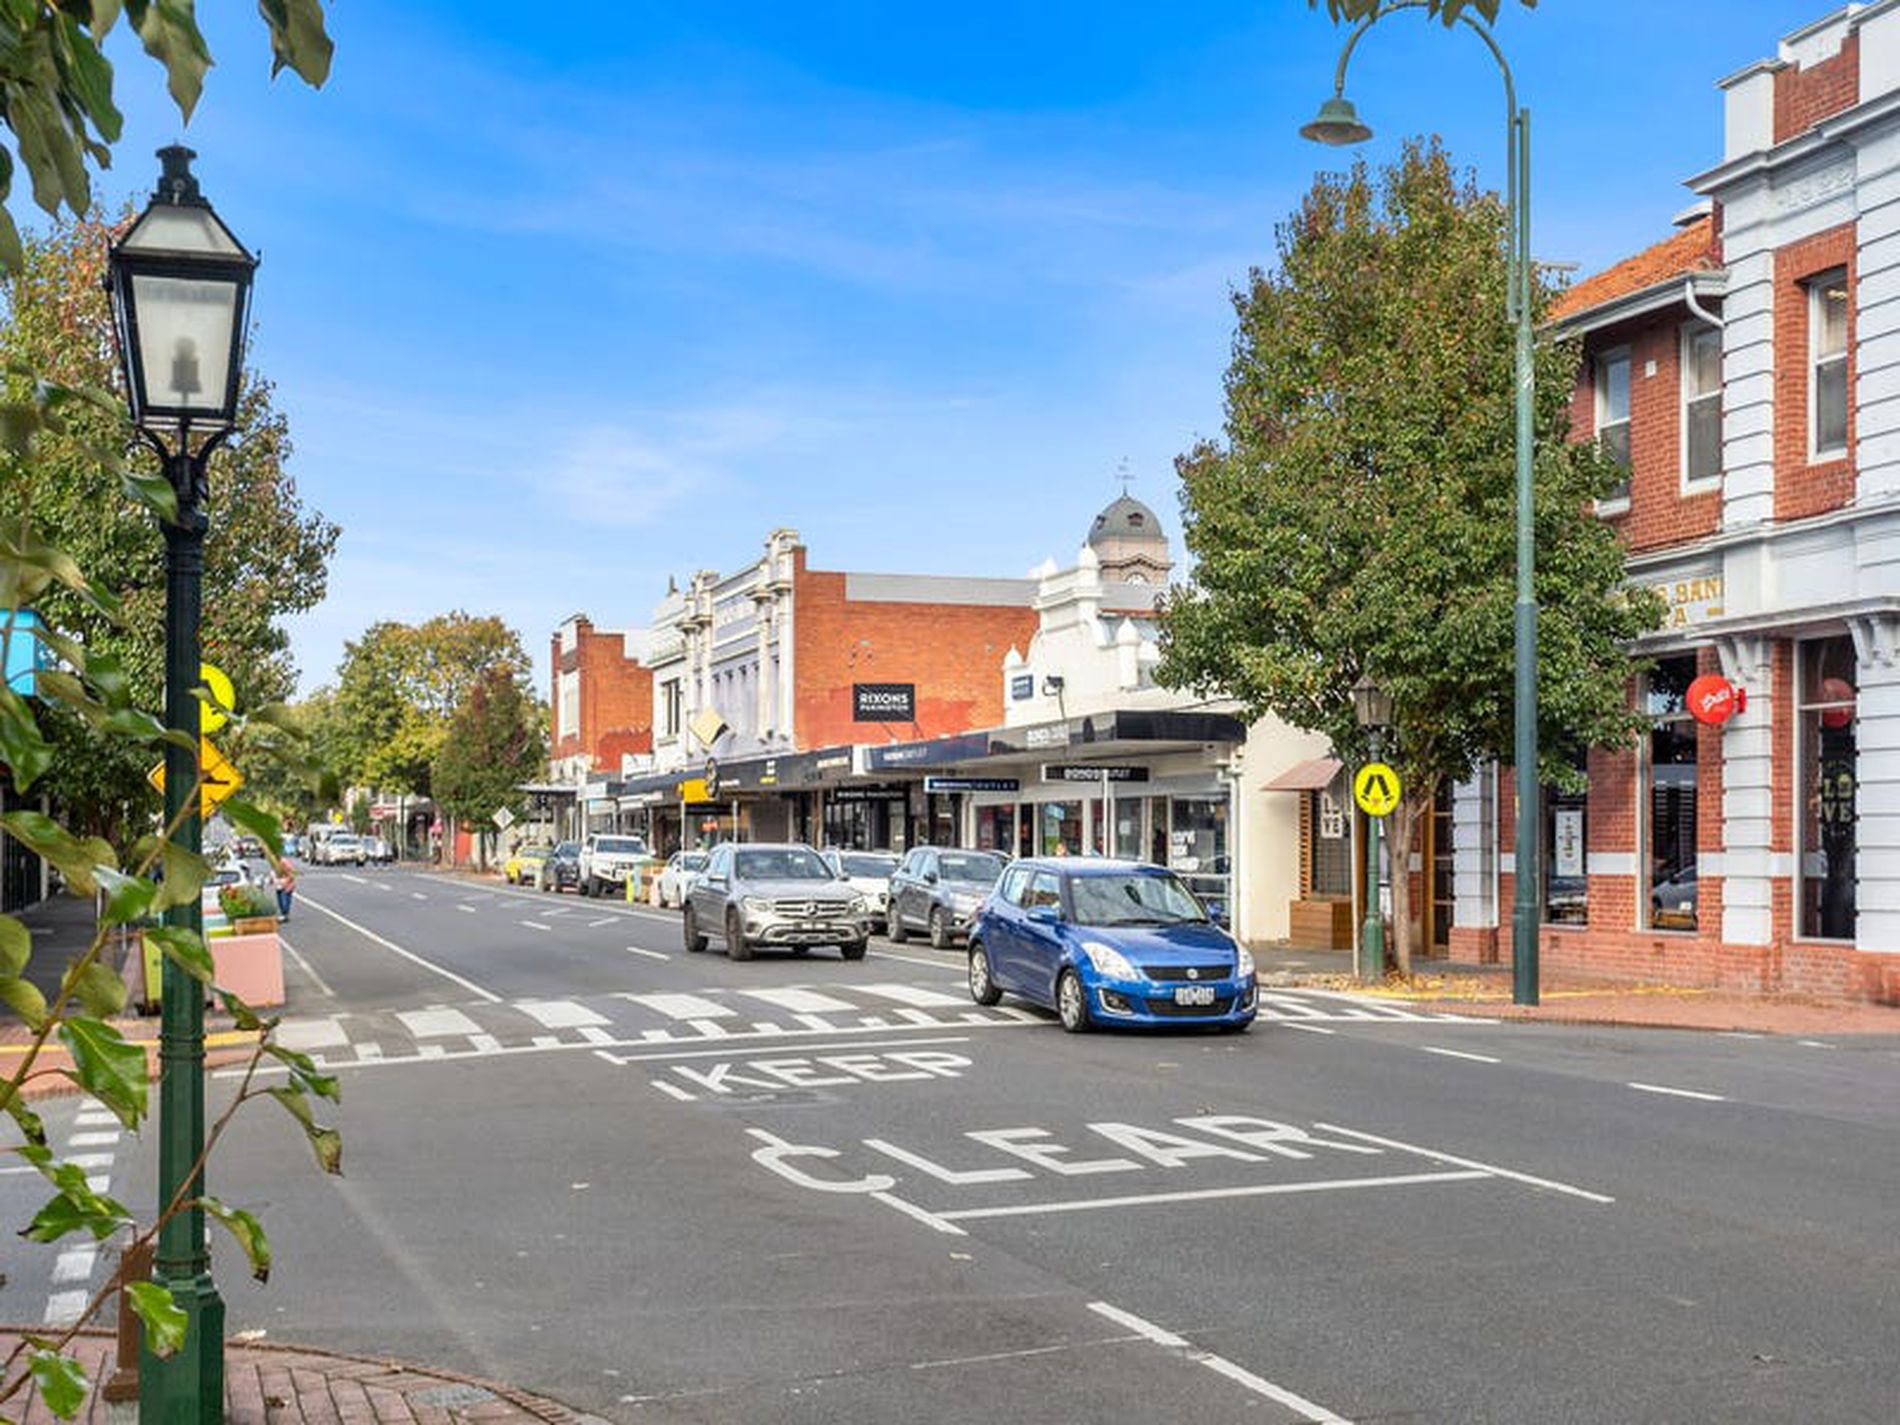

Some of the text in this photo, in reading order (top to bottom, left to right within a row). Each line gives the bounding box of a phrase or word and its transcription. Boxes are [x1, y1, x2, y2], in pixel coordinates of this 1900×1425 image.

[860, 693, 909, 704] RIXONS
[670, 1052, 973, 1093] KEEP
[750, 1116, 1384, 1194] CLEAR
